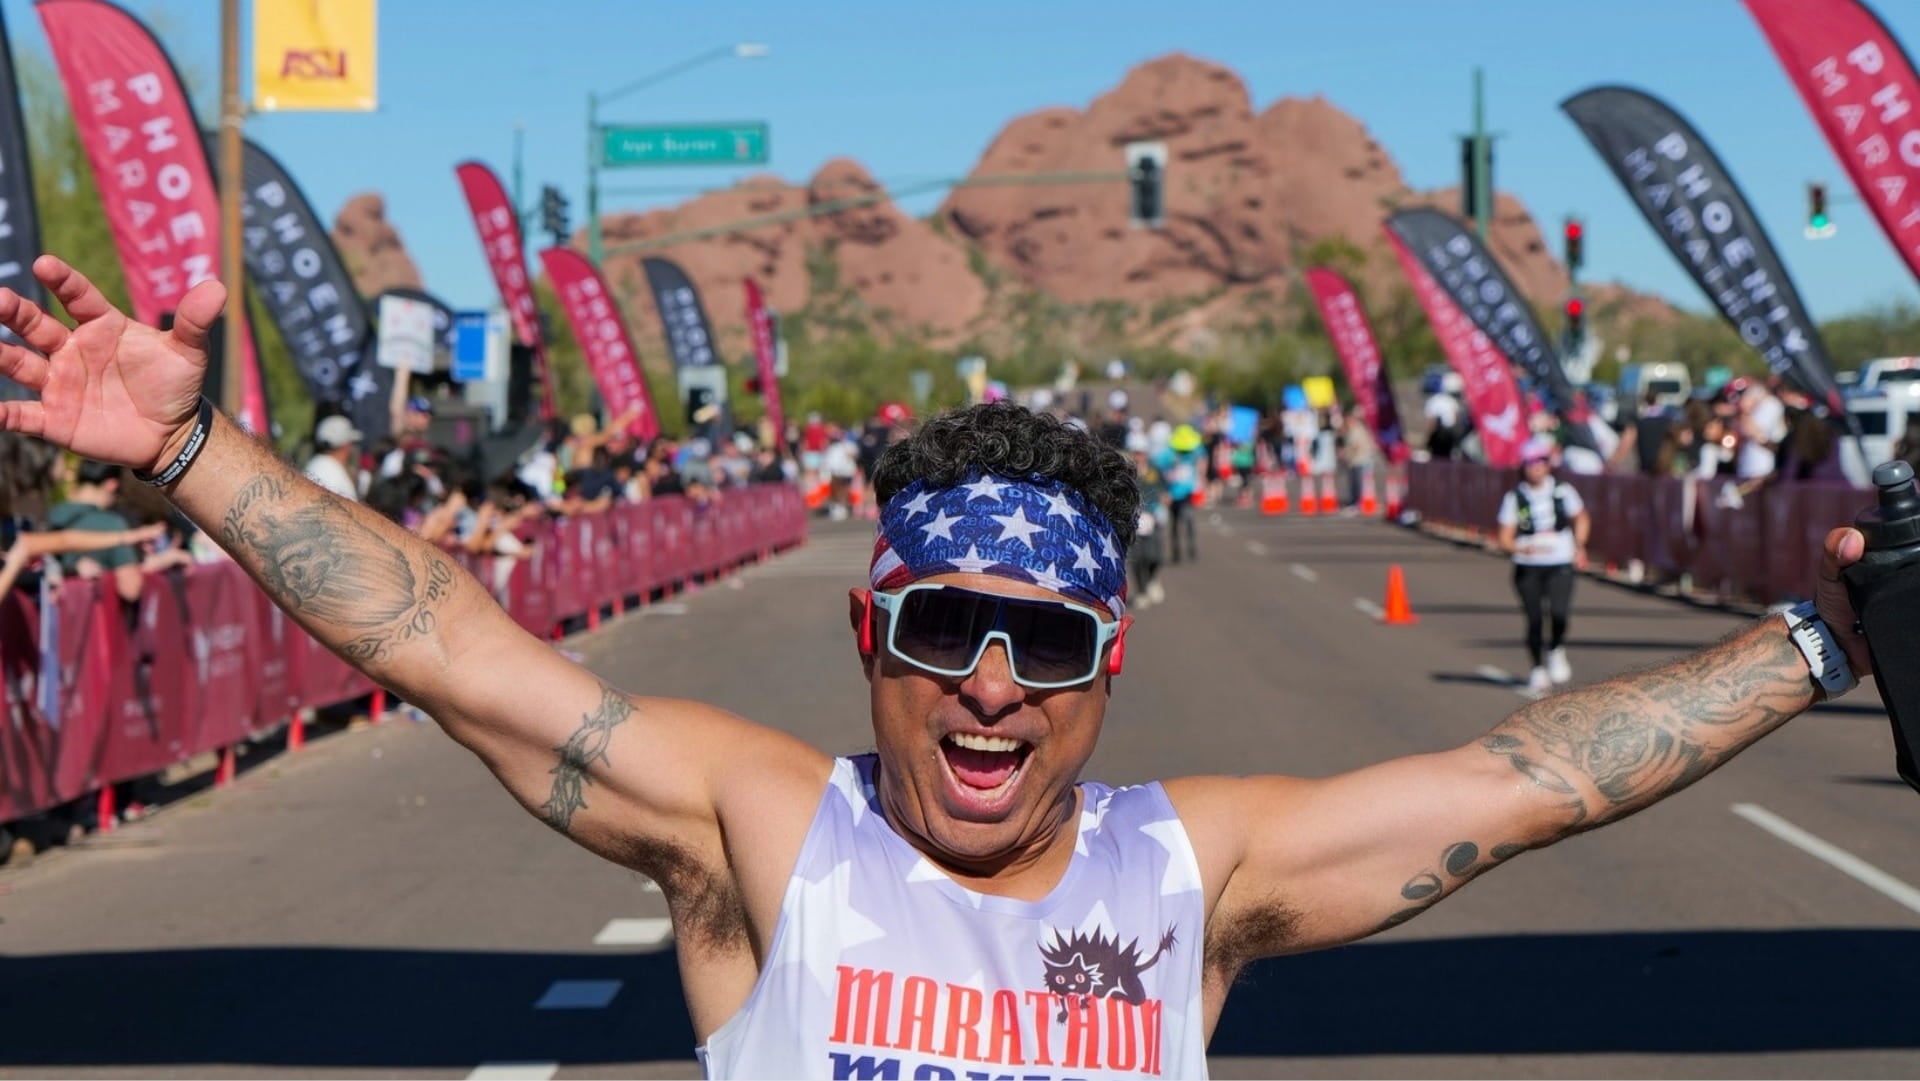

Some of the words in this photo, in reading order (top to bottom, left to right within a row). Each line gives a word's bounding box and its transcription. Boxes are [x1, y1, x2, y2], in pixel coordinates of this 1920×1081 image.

[88, 79, 177, 297] MARATH
[127, 72, 217, 287] PHOEN
[1654, 132, 1809, 353] PHOENIX
[828, 964, 1162, 1077] MARATHON
